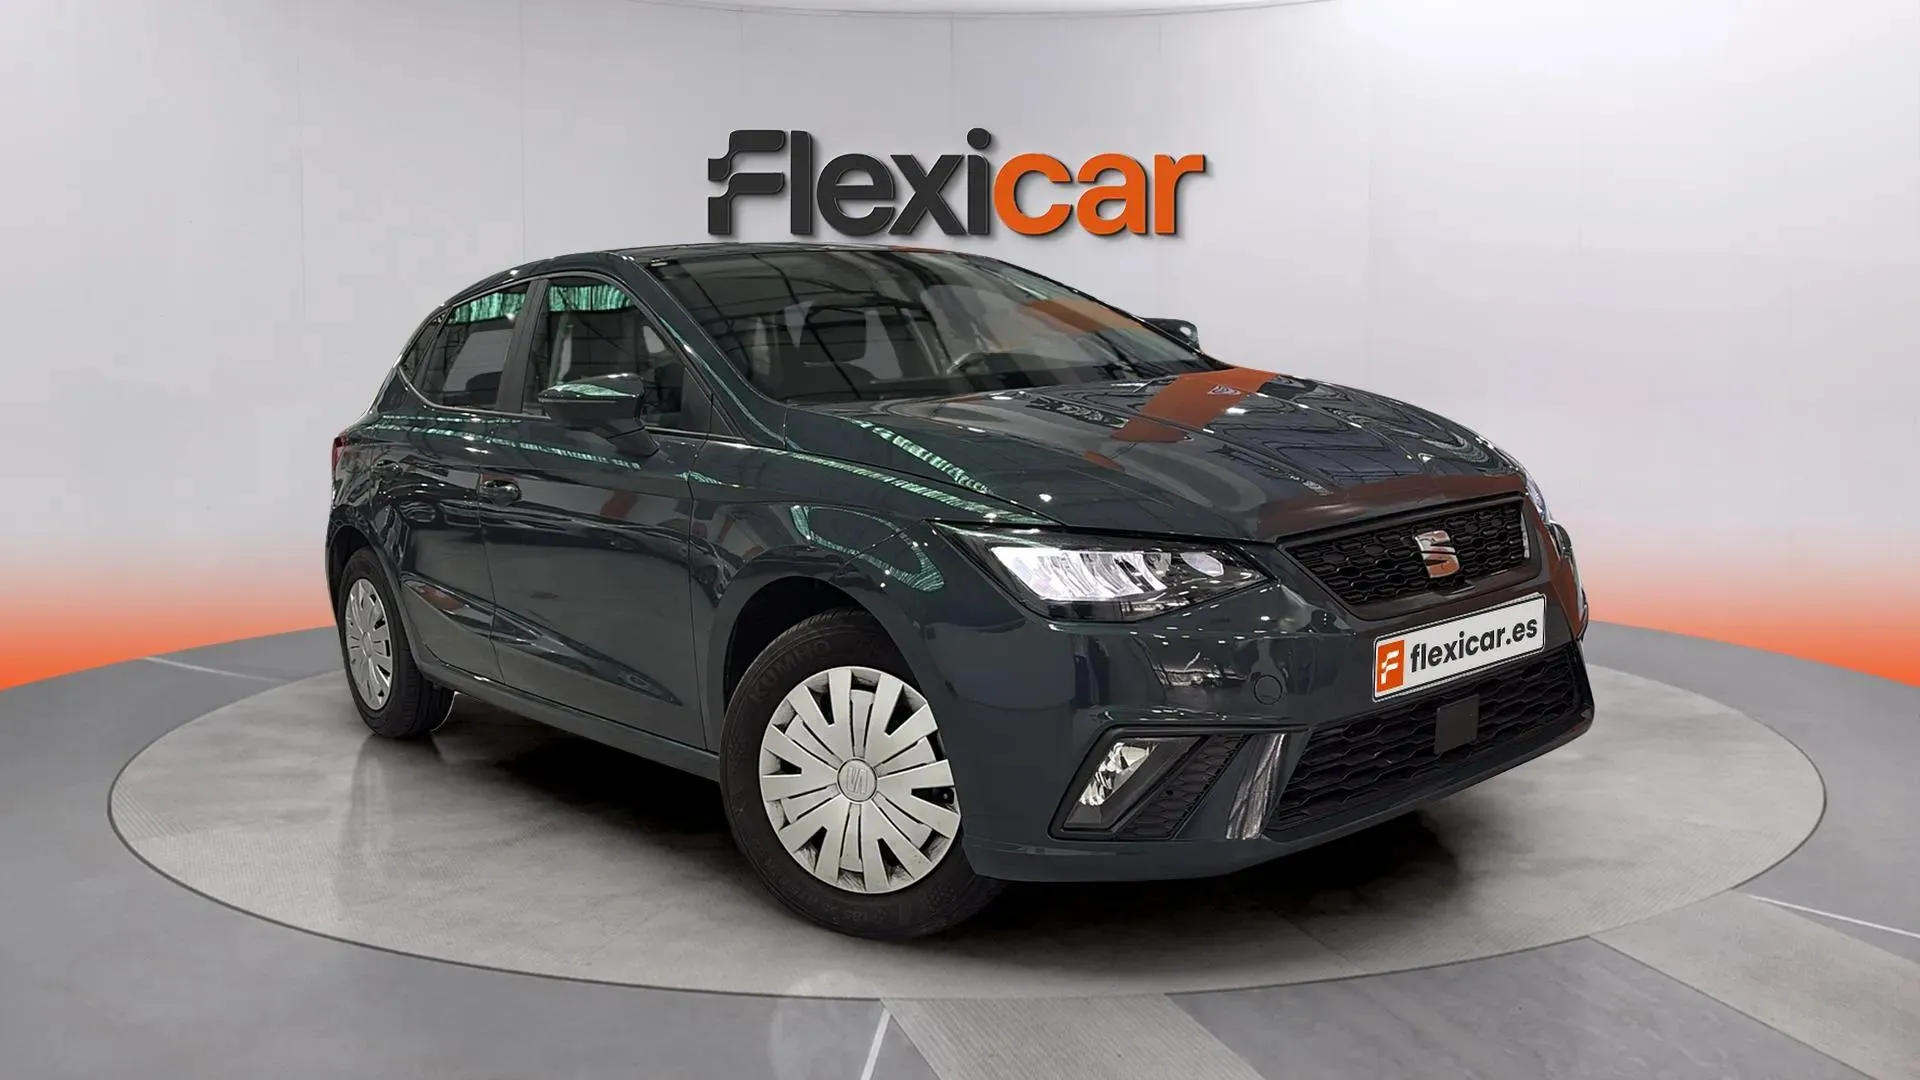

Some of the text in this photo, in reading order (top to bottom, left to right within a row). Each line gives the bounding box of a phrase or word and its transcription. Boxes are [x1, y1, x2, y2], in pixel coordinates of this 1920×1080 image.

[707, 127, 1206, 237] Flexicar
[748, 639, 832, 702] KUMHO
[1410, 618, 1538, 673] flexicar.es
